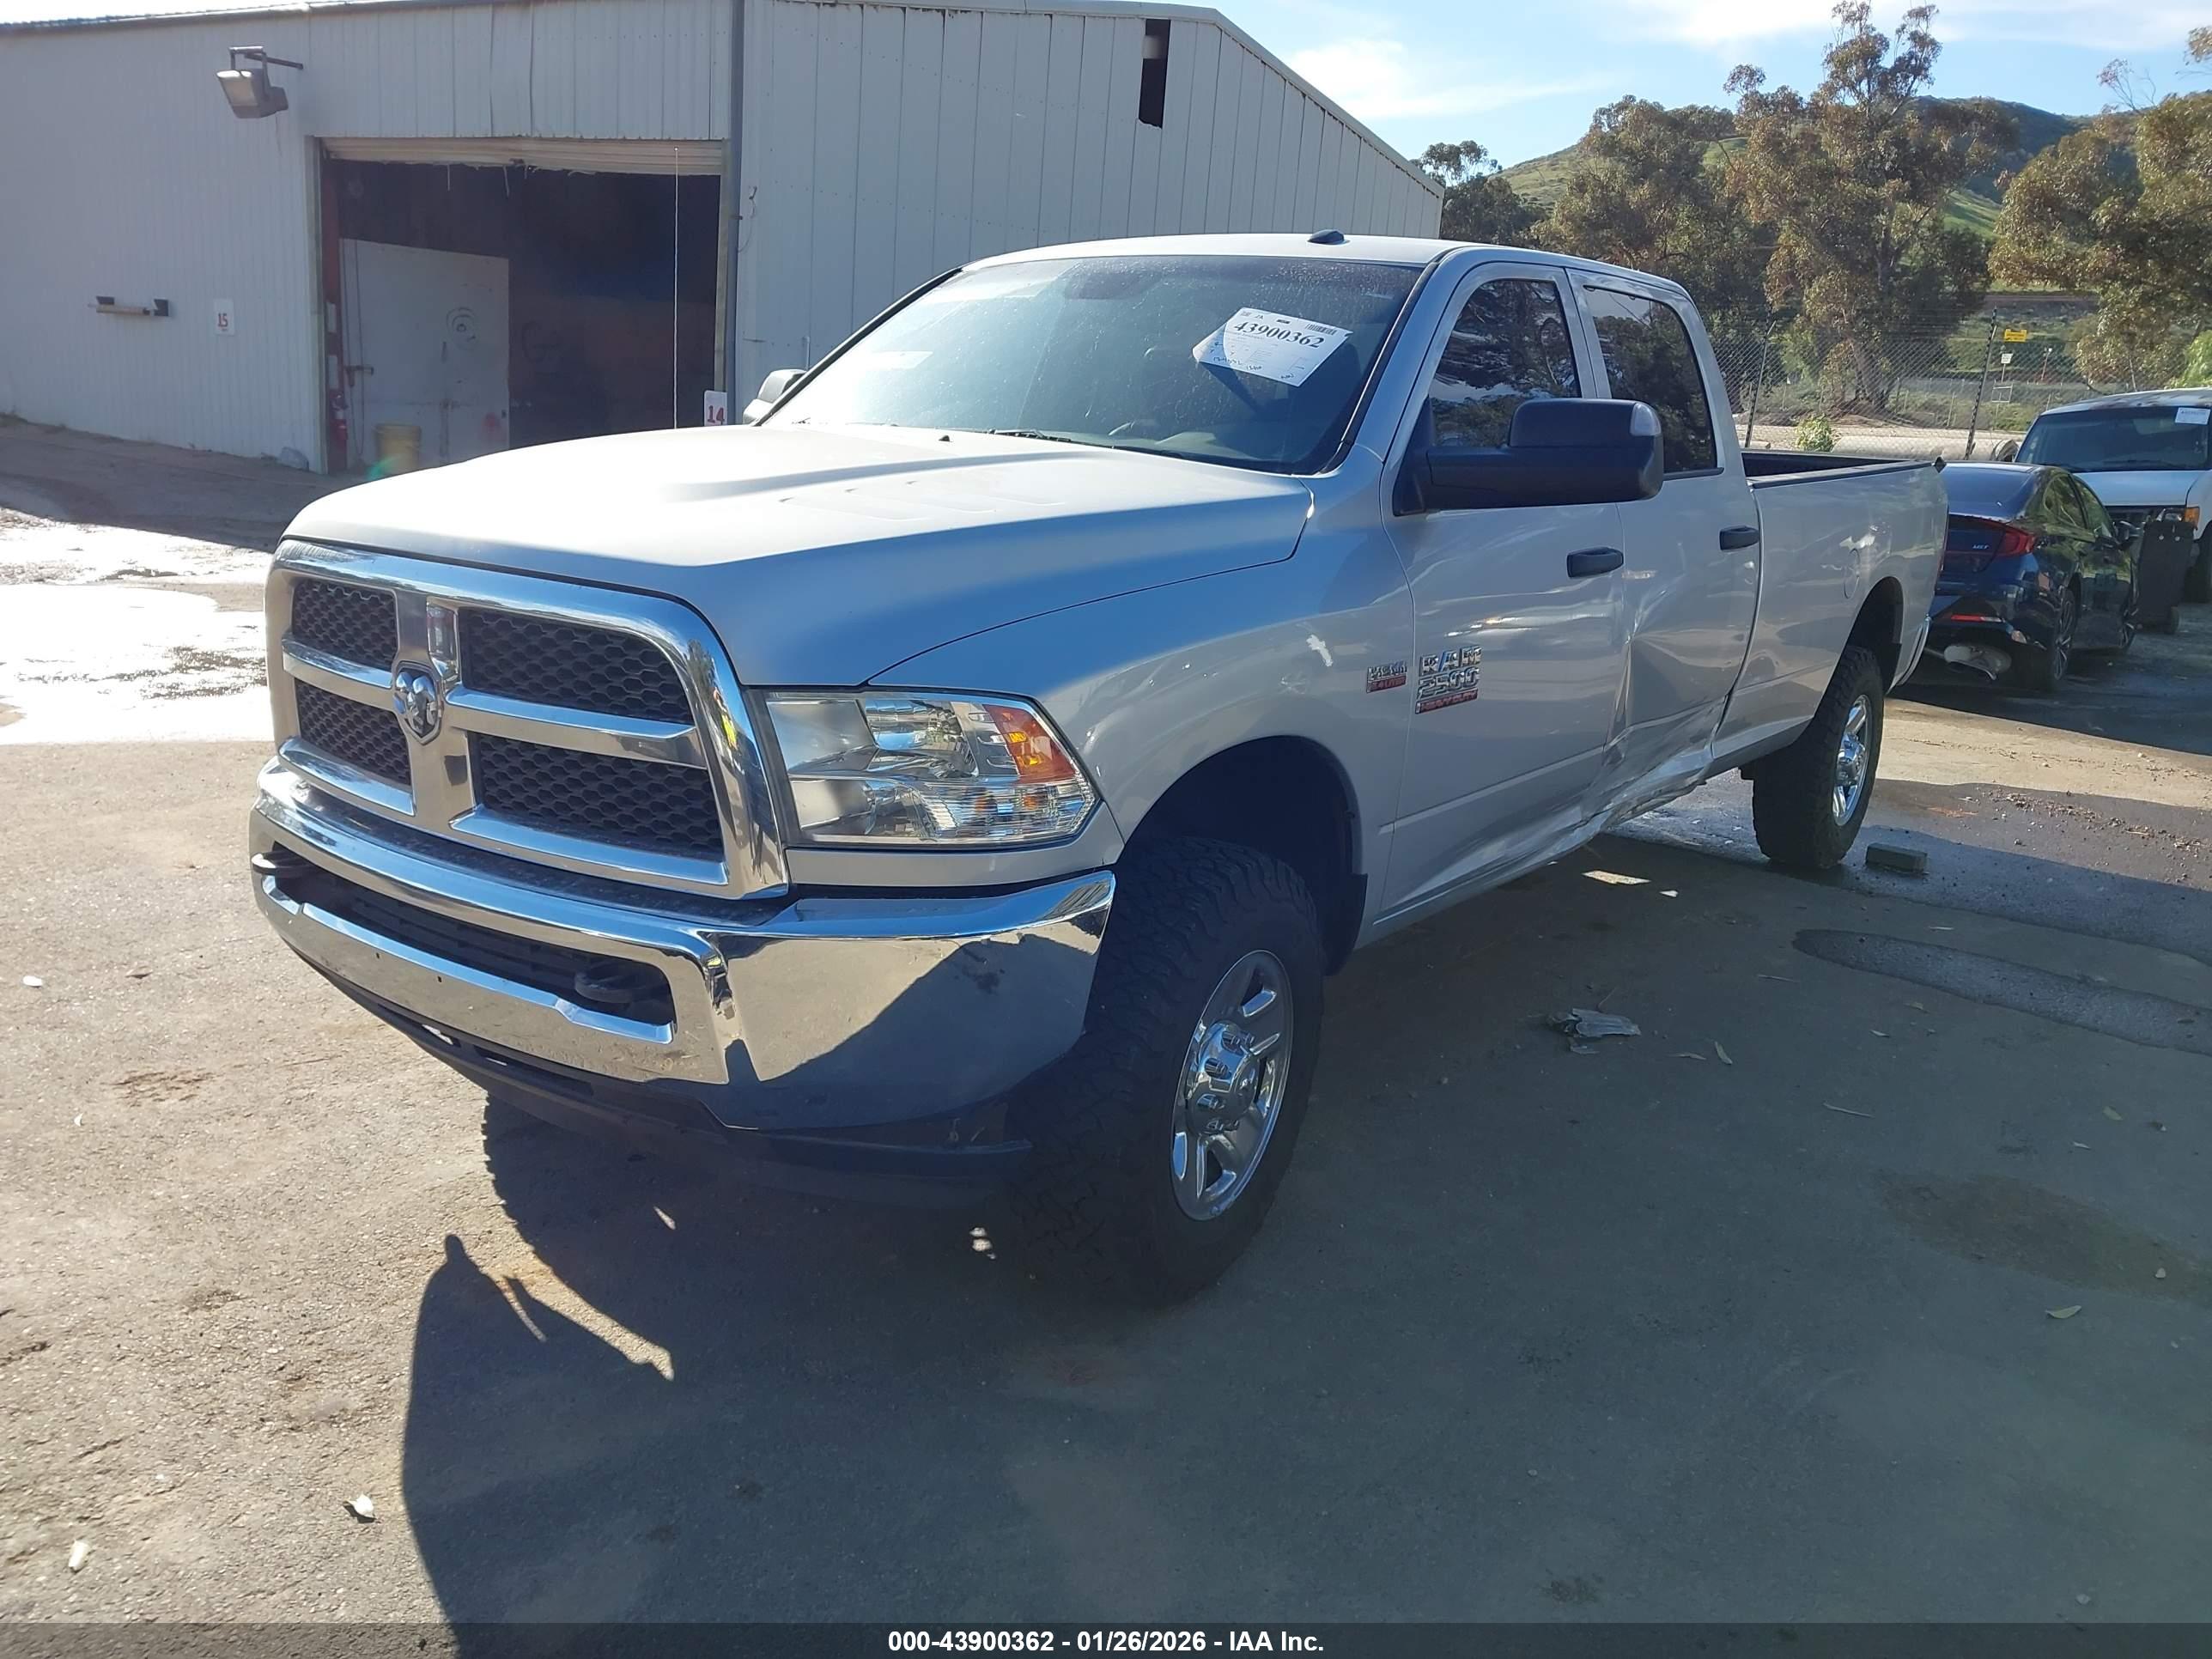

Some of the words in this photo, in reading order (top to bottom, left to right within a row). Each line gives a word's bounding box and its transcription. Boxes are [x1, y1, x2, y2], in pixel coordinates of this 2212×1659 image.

[217, 313, 228, 327] 15
[1234, 320, 1326, 349] 43900362
[708, 405, 725, 425] 14
[1420, 646, 1482, 677] RAM
[1417, 666, 1480, 699] 2500
